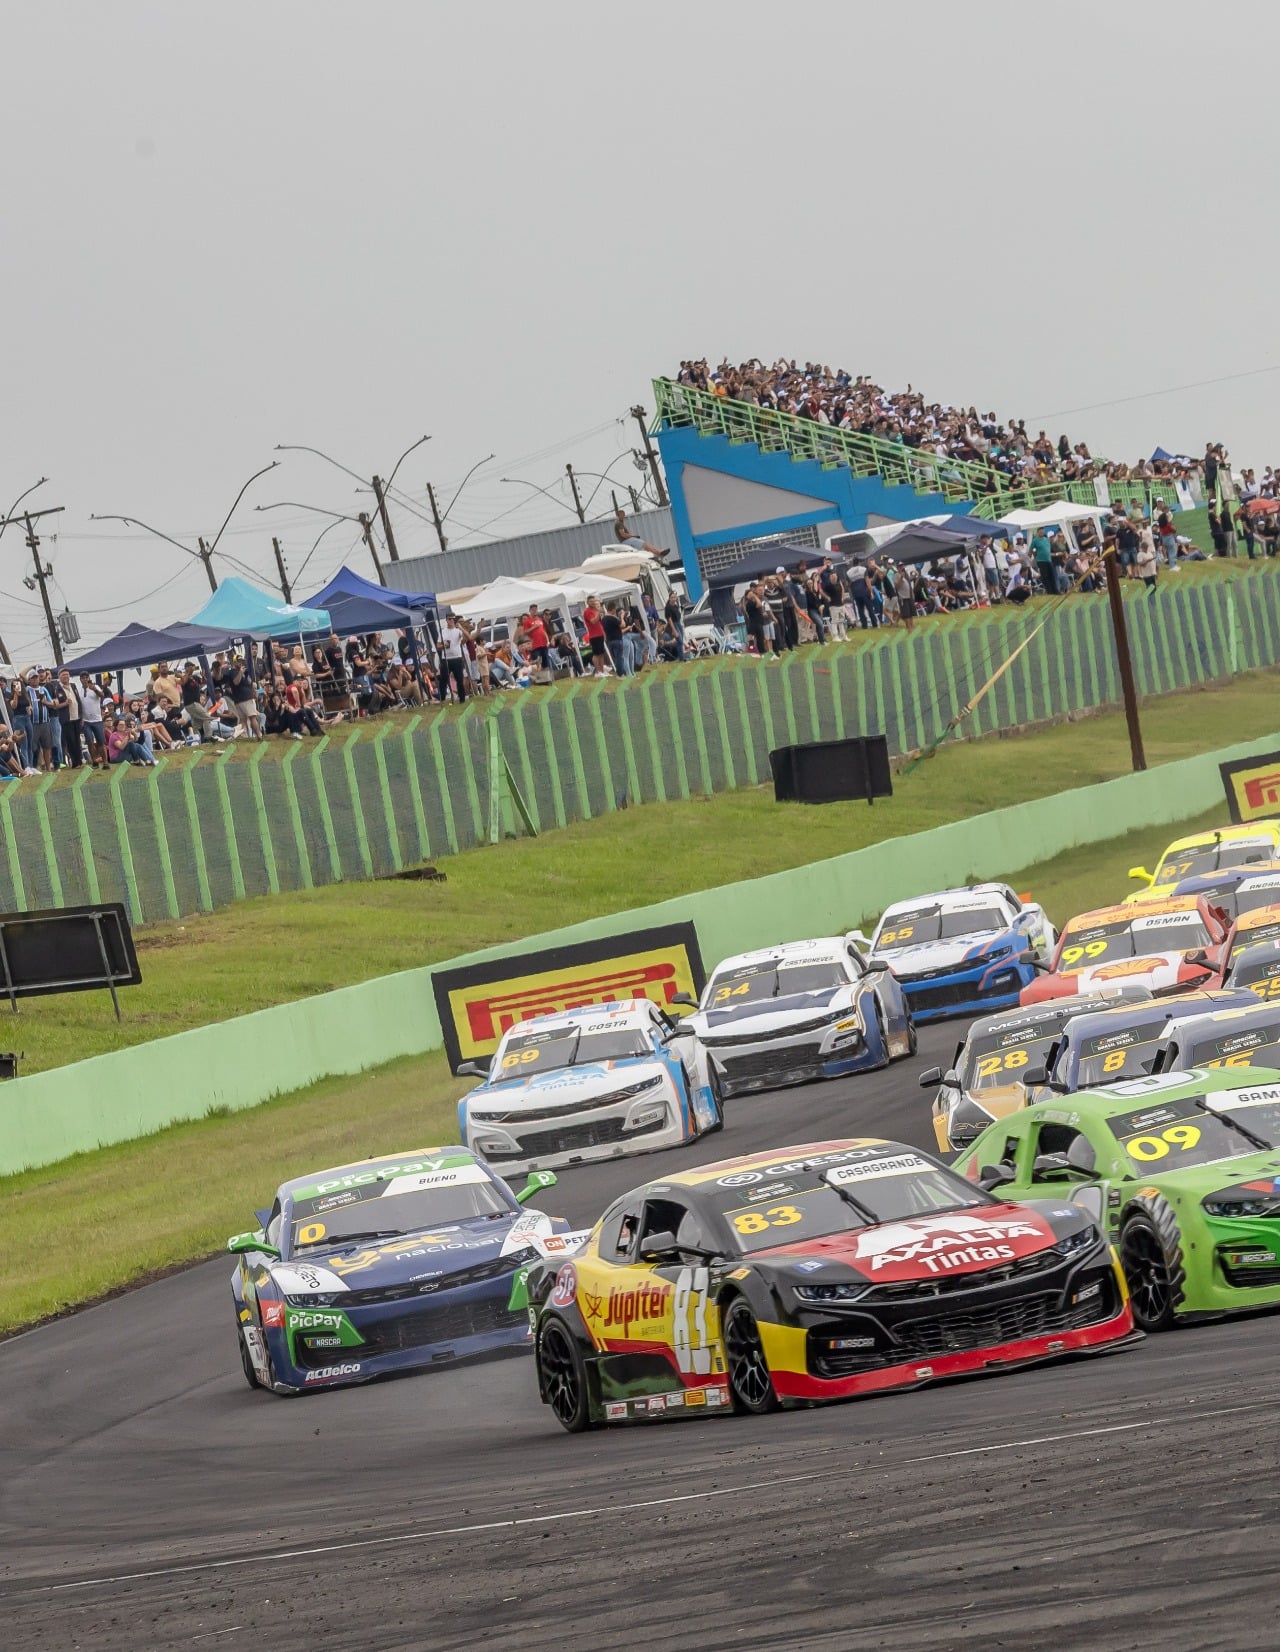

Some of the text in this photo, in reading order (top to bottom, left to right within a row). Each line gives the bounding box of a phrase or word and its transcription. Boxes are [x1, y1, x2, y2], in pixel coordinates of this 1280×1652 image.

[1146, 915, 1191, 927] OSMAN
[881, 927, 914, 945] 85
[785, 955, 835, 967] CASTRONEVES
[1062, 941, 1107, 965] 99
[715, 983, 750, 1002] 34
[588, 1019, 628, 1032] COSTA
[988, 1001, 1110, 1033] MOTORISTA
[502, 1049, 540, 1068] 69
[979, 1050, 1029, 1078] 28
[1103, 1050, 1127, 1073] 8
[1126, 1124, 1202, 1163] 09
[765, 1147, 890, 1176] CRESOL
[837, 1156, 925, 1180] CASAGRANDE
[316, 1158, 446, 1195] PicPay
[419, 1173, 457, 1185] BUENO
[734, 1204, 803, 1235] 83
[299, 1222, 327, 1245] 0
[546, 1238, 564, 1251] ON
[395, 1235, 503, 1262] nacional
[870, 1225, 1046, 1271] AXALTA
[918, 1242, 1016, 1273] Tintas
[409, 1270, 444, 1281] CHEVROLET
[555, 1269, 577, 1301] STP
[289, 1310, 343, 1331] PicPay
[673, 1267, 712, 1375] 83
[316, 1337, 342, 1347] NASCAR
[841, 1336, 876, 1349] NASCAR
[304, 1363, 361, 1384] ACDelco
